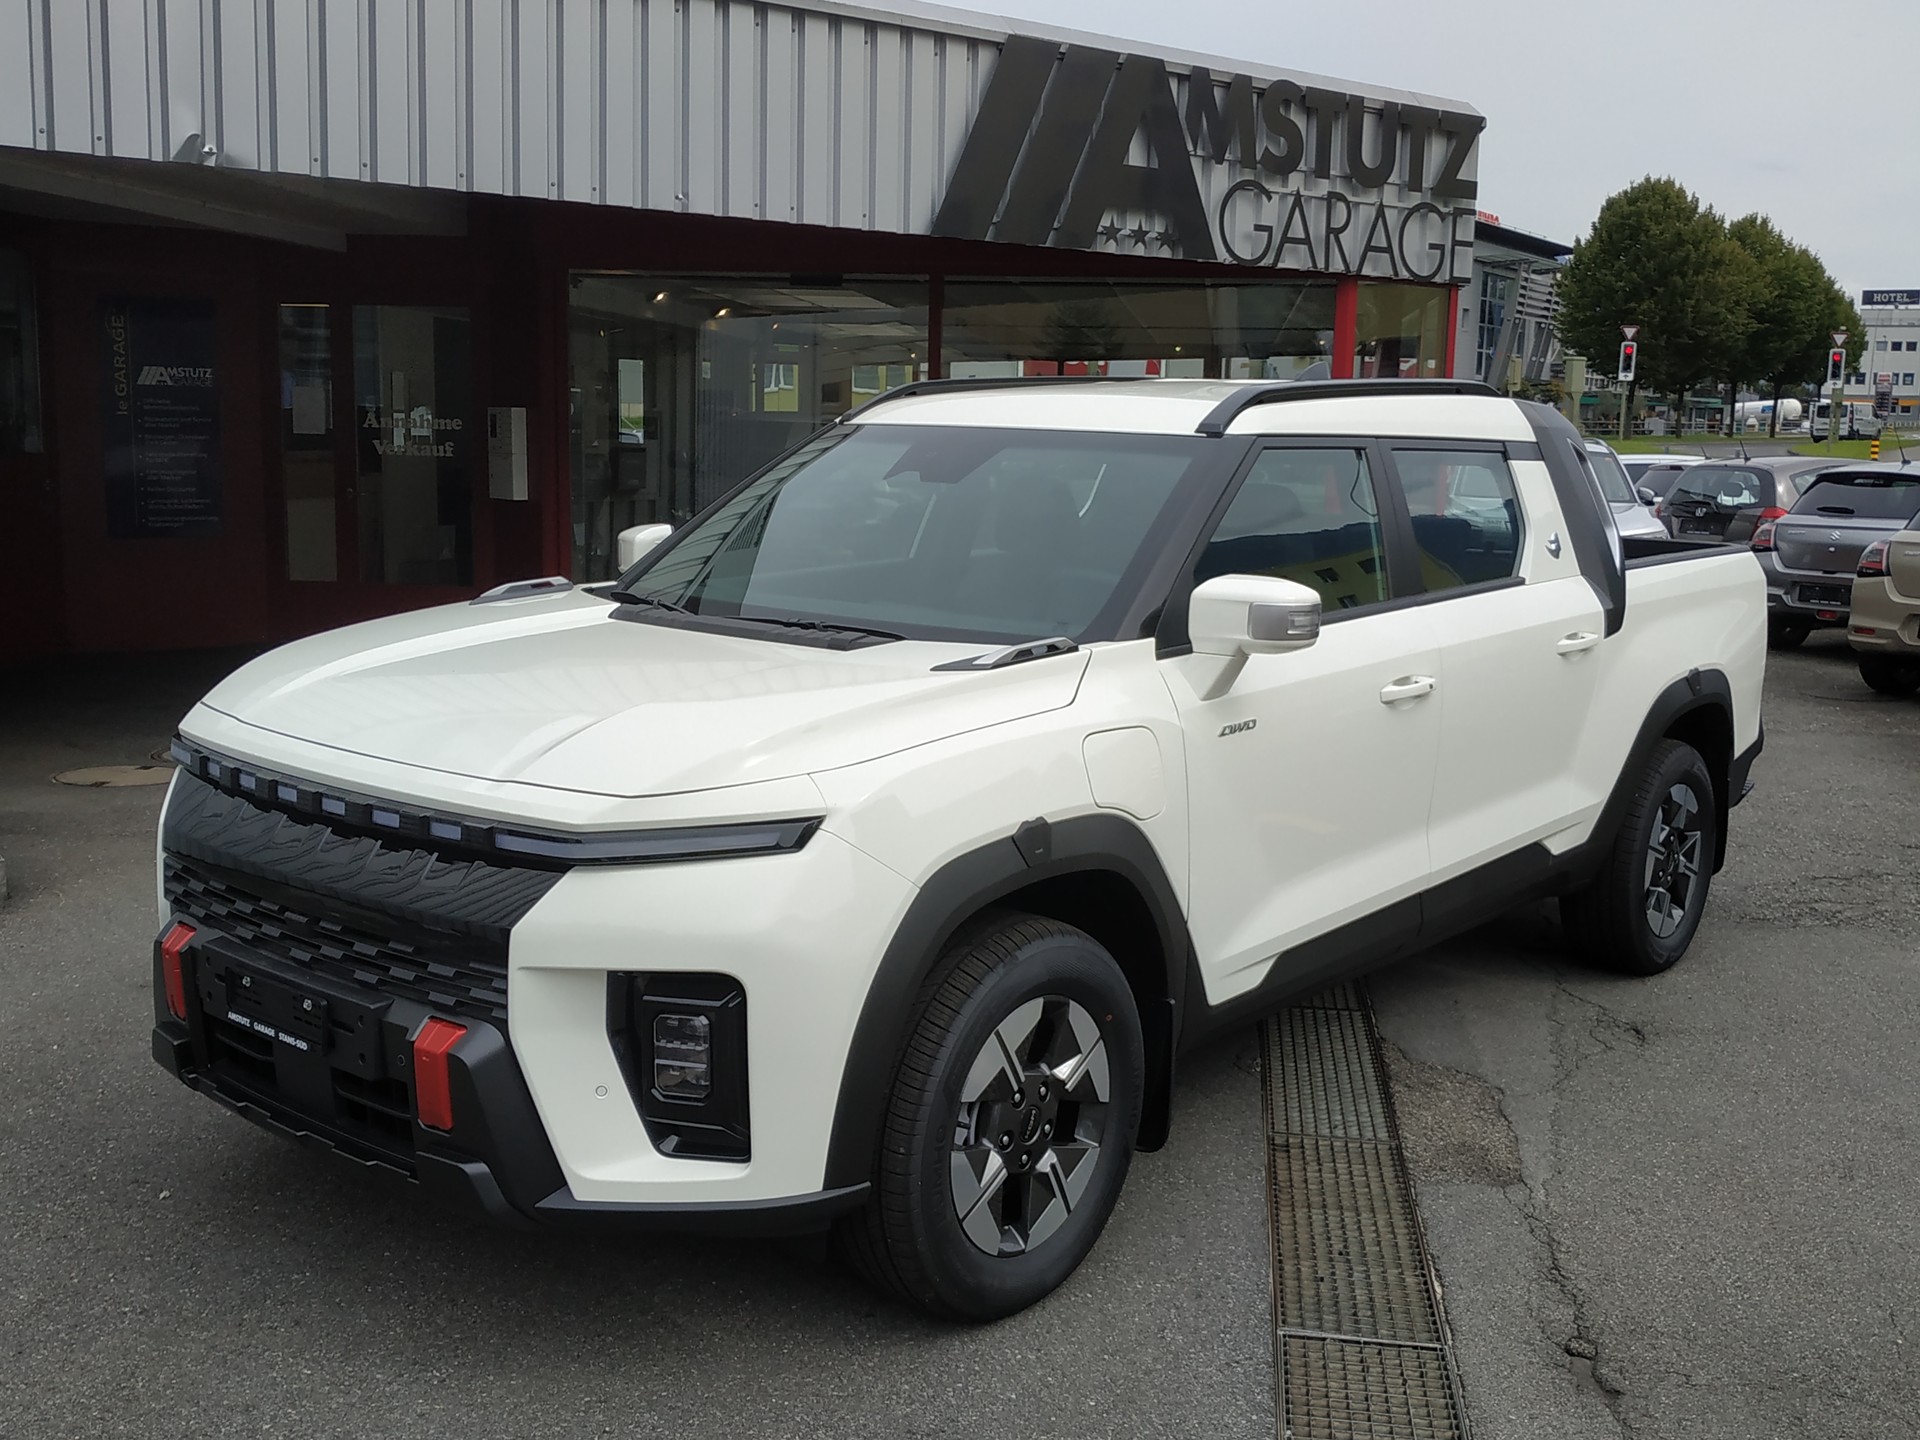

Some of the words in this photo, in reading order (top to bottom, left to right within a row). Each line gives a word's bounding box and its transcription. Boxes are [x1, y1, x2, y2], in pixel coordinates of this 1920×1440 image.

[1040, 50, 1487, 262] AMSTUTZ
[1218, 179, 1478, 286] GARAGE
[1872, 292, 1909, 303] HOTEL
[111, 314, 128, 397] GARAGE
[147, 365, 214, 386] AMSTUTZ
[115, 401, 129, 416] le
[362, 411, 463, 431] Annahme
[372, 439, 456, 458] Verkauf
[227, 1011, 251, 1028] AMSTUTZ
[253, 1021, 276, 1038] GARAGE
